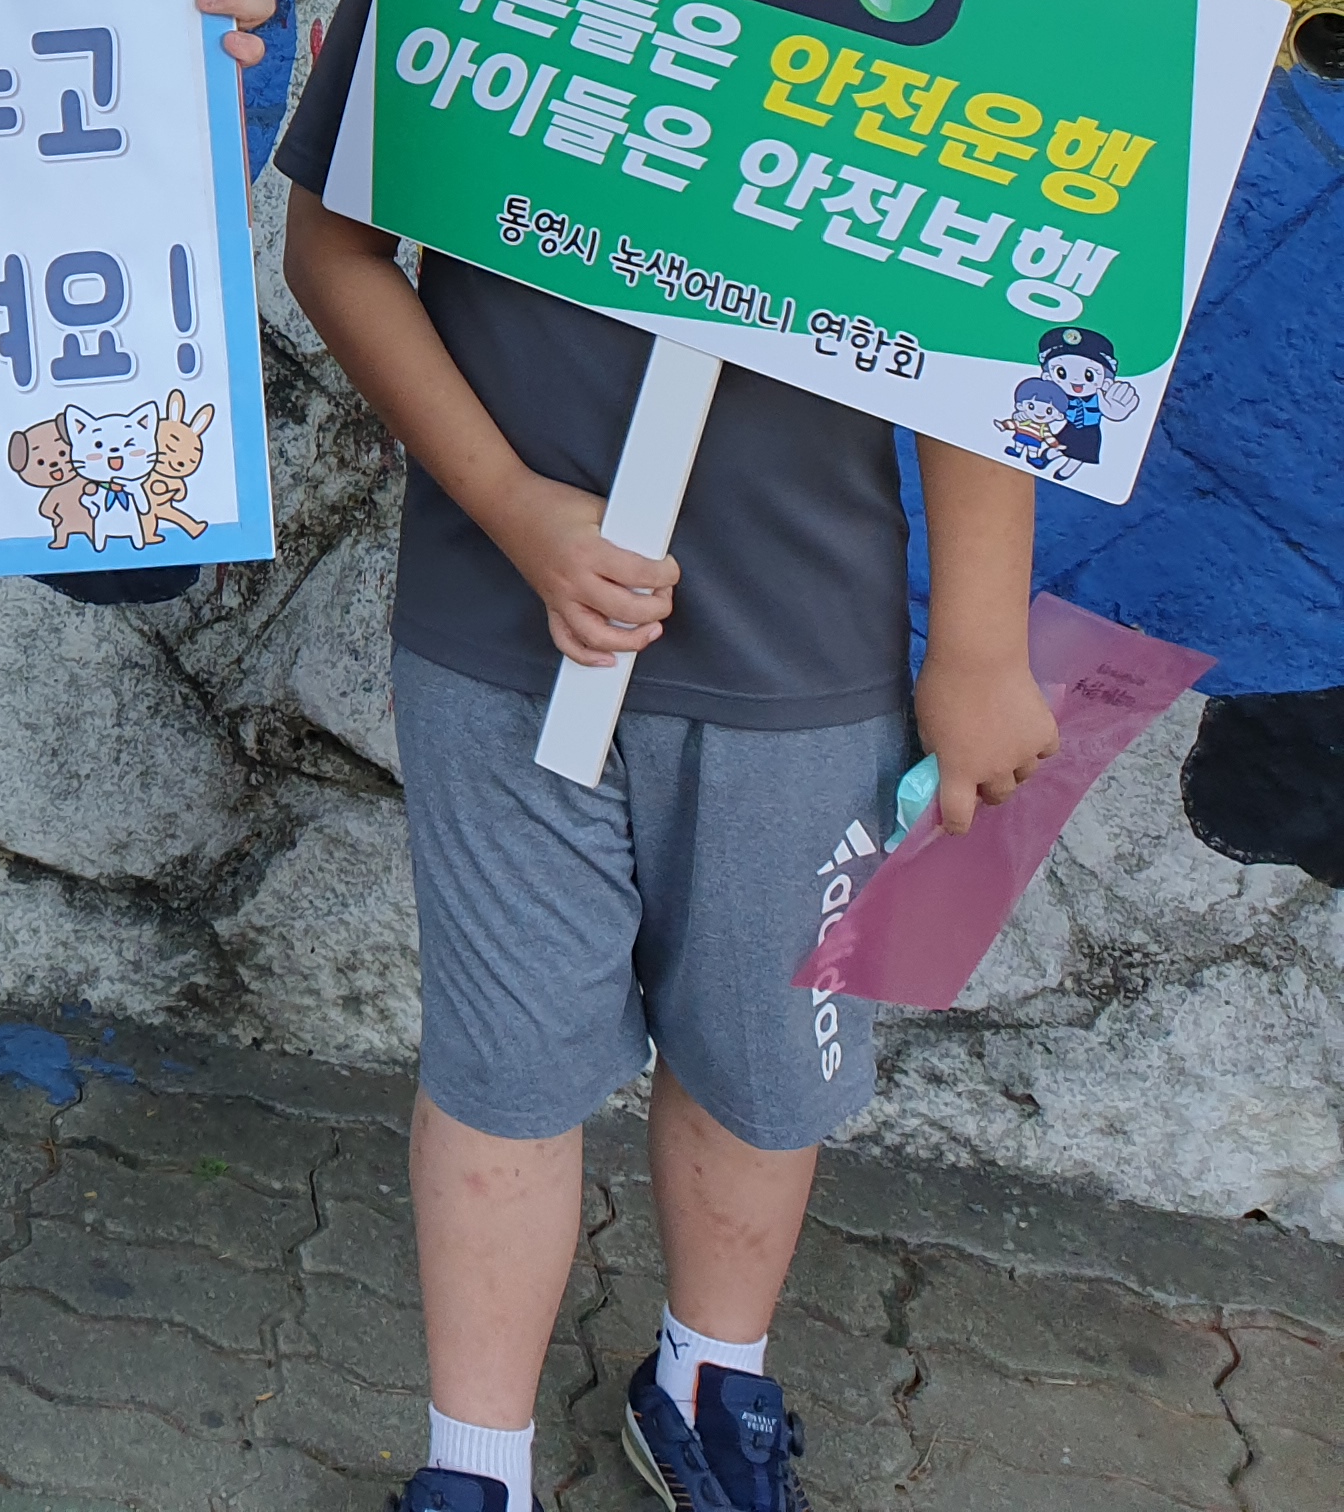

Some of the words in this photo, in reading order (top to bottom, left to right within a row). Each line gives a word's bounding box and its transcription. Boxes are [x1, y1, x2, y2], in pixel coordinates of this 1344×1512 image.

[394, 26, 713, 193] 아이들은
[732, 138, 1119, 323] 안전보행
[763, 33, 1157, 217] 안전운행
[497, 196, 599, 265] 통영시
[611, 236, 794, 336] 녹색어머니
[808, 307, 927, 382] 연합회
